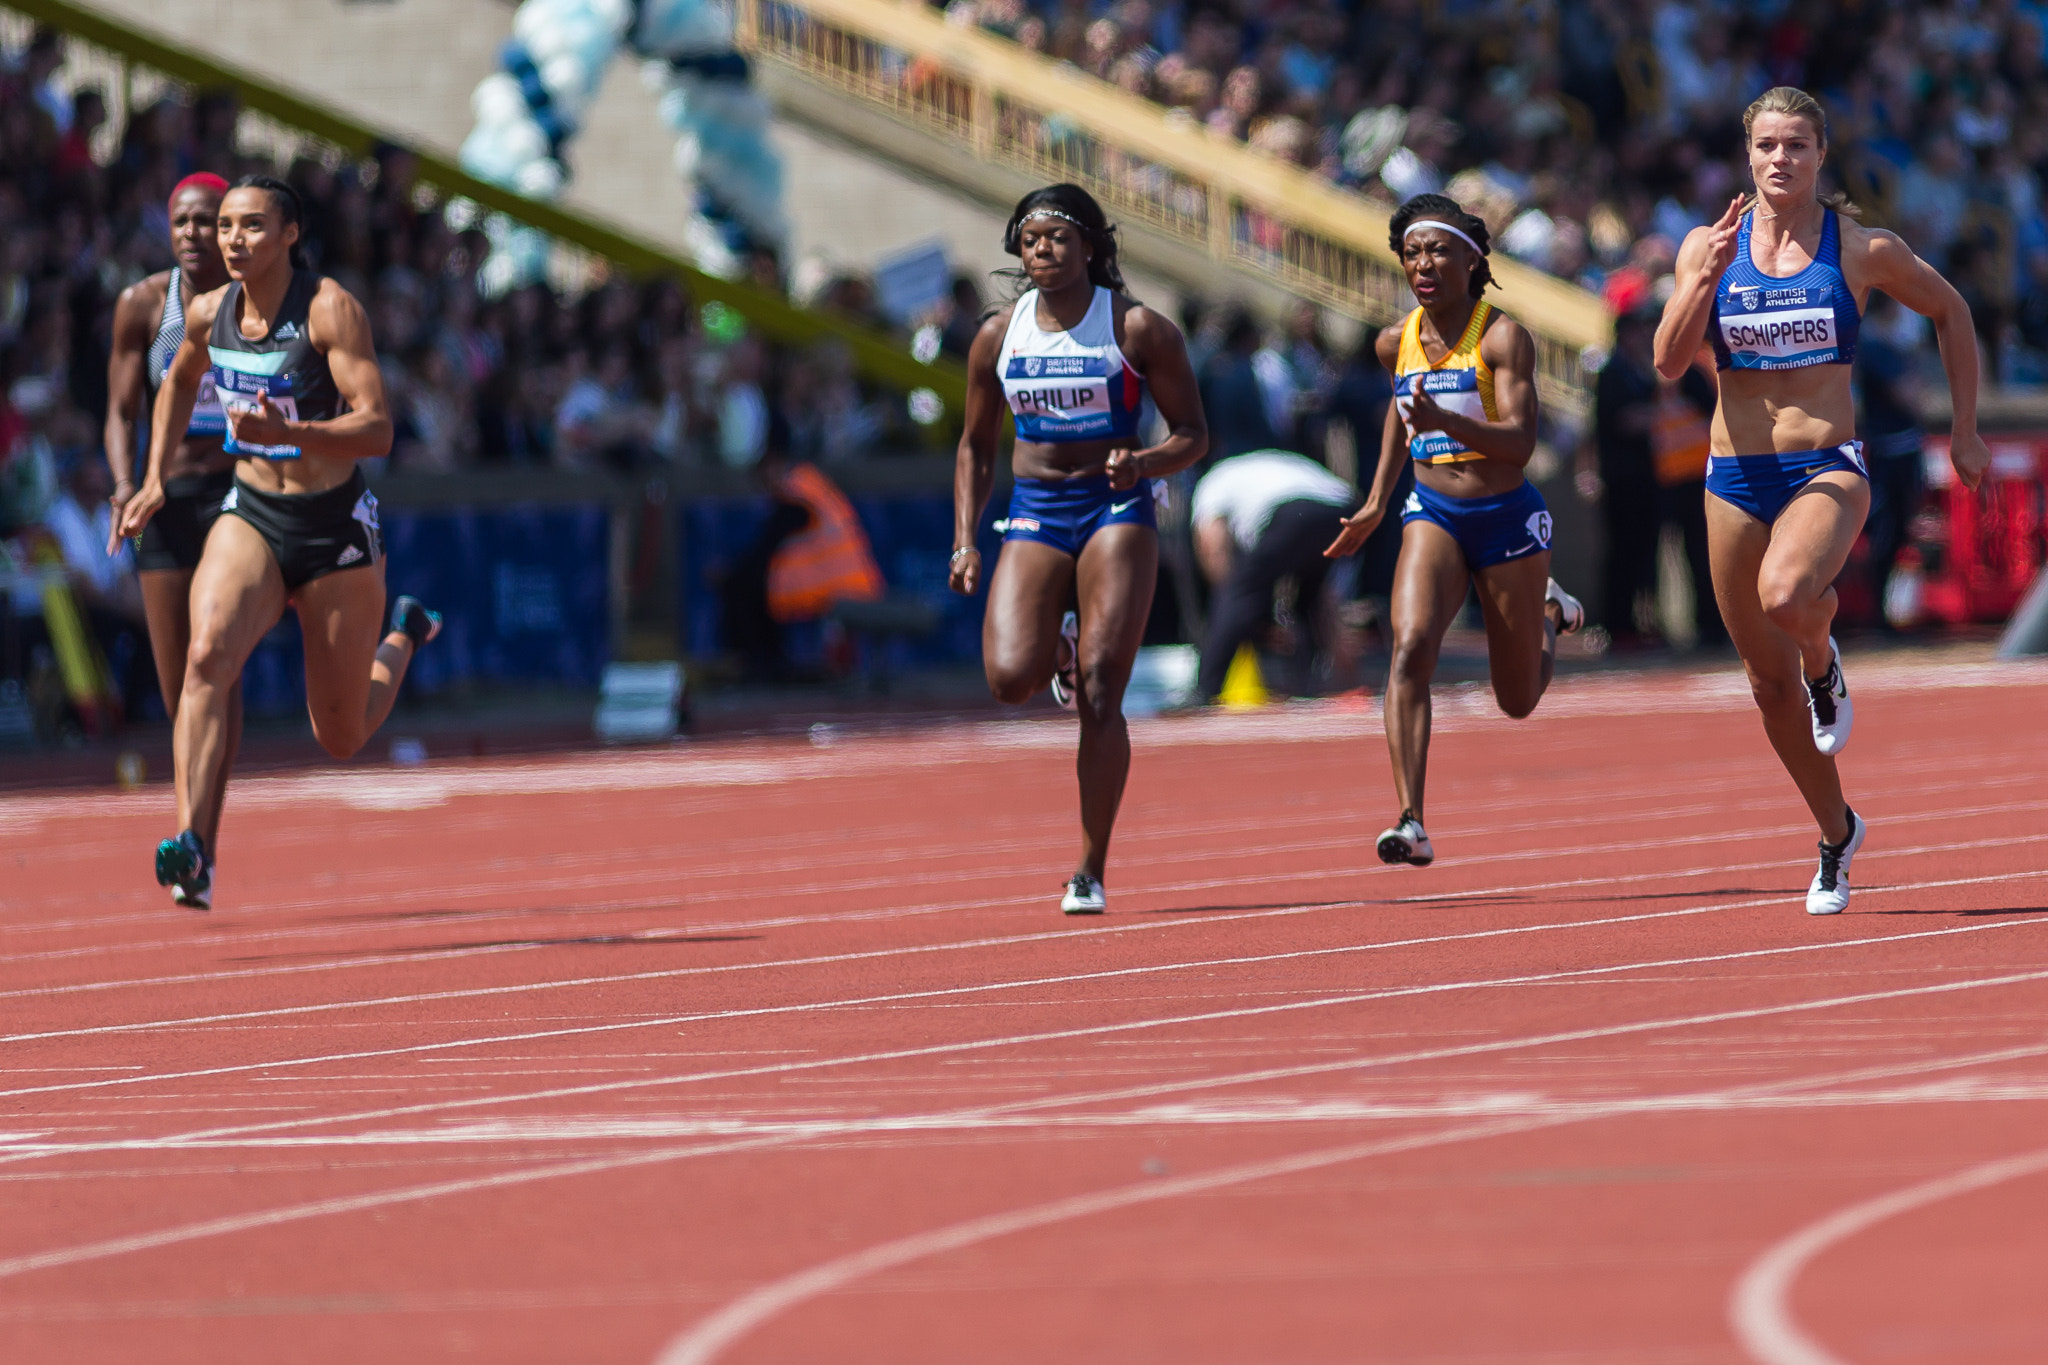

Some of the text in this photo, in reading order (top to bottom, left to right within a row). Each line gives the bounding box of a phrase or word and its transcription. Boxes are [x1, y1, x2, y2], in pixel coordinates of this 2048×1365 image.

[1765, 287, 1806, 299] BRITISH
[1765, 297, 1808, 307] ATHLETICS
[1729, 318, 1829, 348] SCHIPPERS
[1760, 352, 1834, 370] Birmingham
[1017, 388, 1094, 410] PHILIP
[1040, 418, 1108, 433] Birmingham
[1538, 512, 1549, 542] 6
